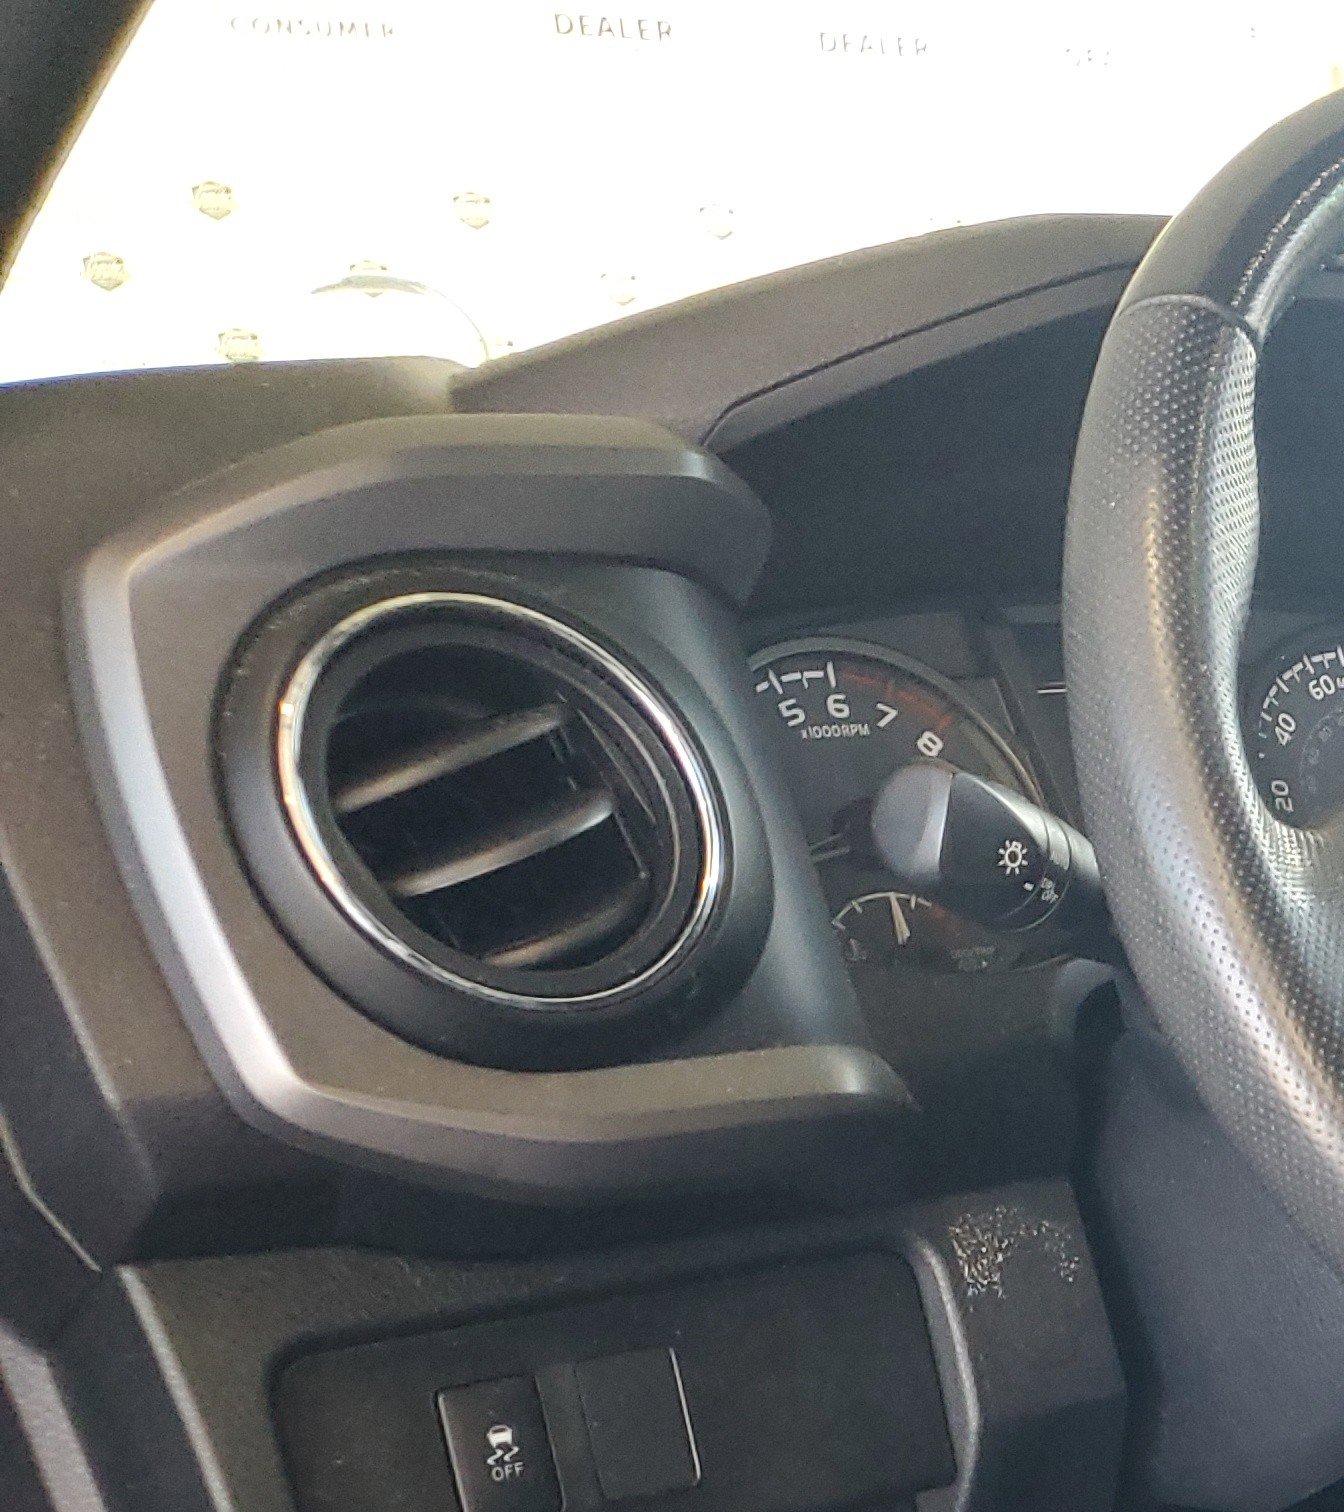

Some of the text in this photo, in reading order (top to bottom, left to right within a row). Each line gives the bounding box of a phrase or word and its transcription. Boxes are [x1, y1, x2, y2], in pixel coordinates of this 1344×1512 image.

[230, 16, 394, 38] CONUMR
[554, 13, 673, 42] DEALER
[1308, 673, 1336, 701] 60
[777, 692, 944, 757] 5 6 7 8
[1274, 712, 1297, 746] 40
[1270, 779, 1294, 813] 20
[490, 1461, 525, 1482] OFF
